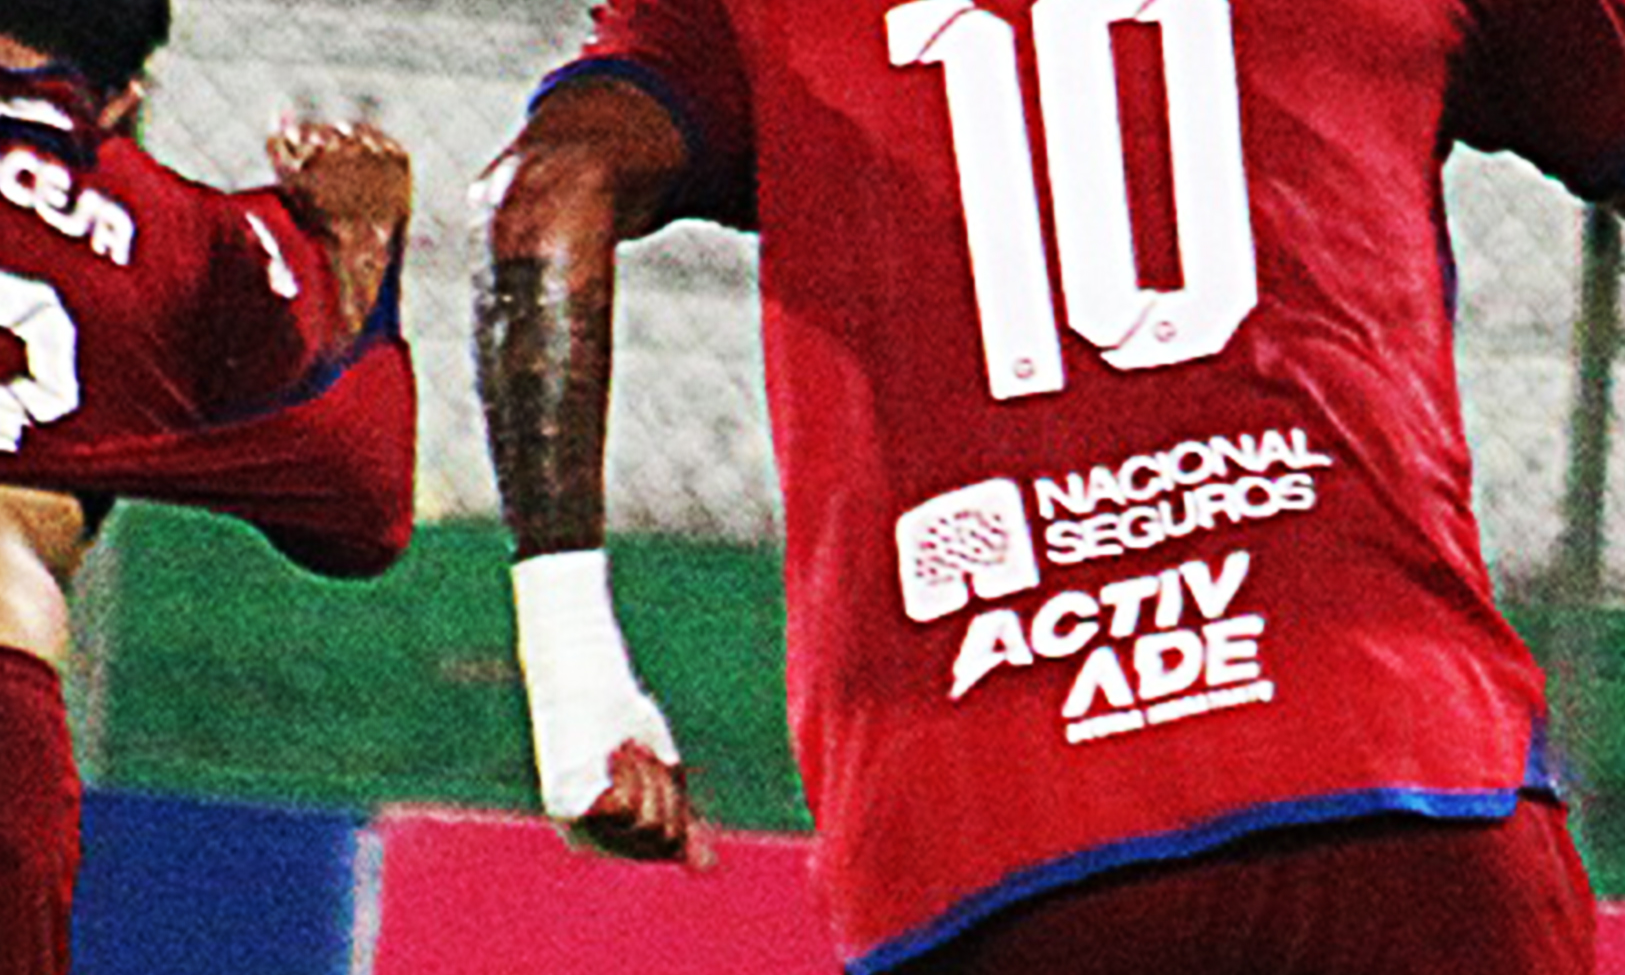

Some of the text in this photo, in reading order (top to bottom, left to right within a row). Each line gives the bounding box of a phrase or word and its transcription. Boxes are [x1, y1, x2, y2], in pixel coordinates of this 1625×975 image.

[1033, 427, 1333, 519] NACIONAL
[1045, 474, 1316, 564] SEGUROS
[947, 550, 1250, 700] ACTIV
